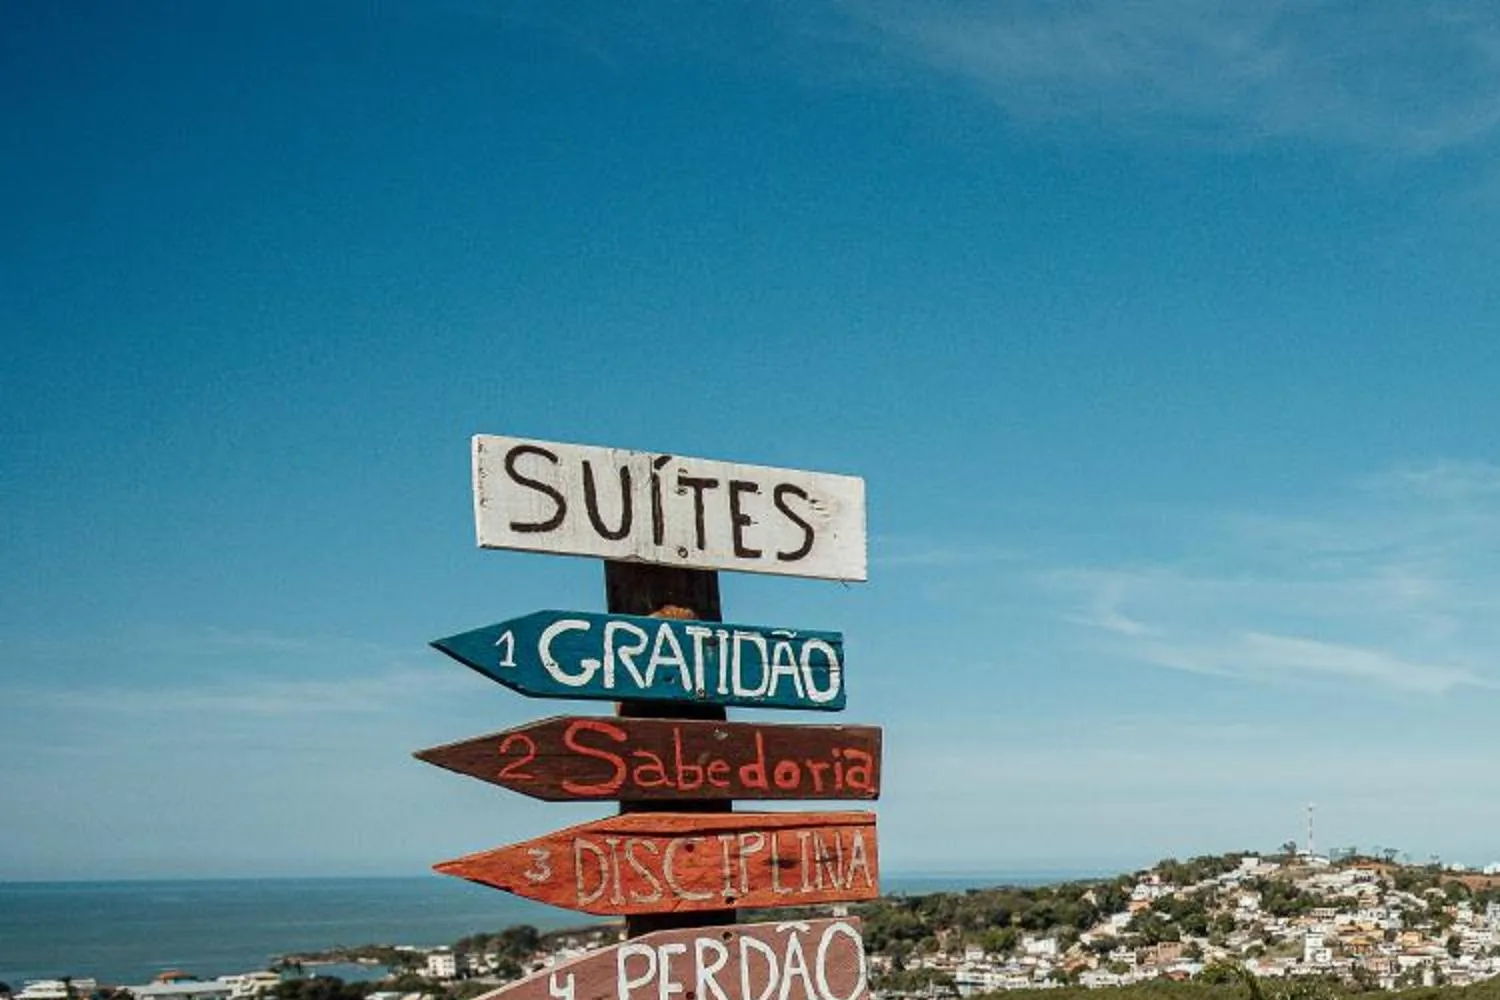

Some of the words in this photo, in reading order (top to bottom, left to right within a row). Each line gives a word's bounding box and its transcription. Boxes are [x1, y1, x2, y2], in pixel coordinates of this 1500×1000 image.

[505, 444, 816, 562] SUÍTES
[495, 629, 516, 668] 1
[538, 619, 841, 703] GRATIDÃO
[499, 734, 538, 781] 2
[561, 720, 876, 796] Sabedoria
[523, 847, 551, 883] 3
[573, 829, 873, 906] DISCIPLINA
